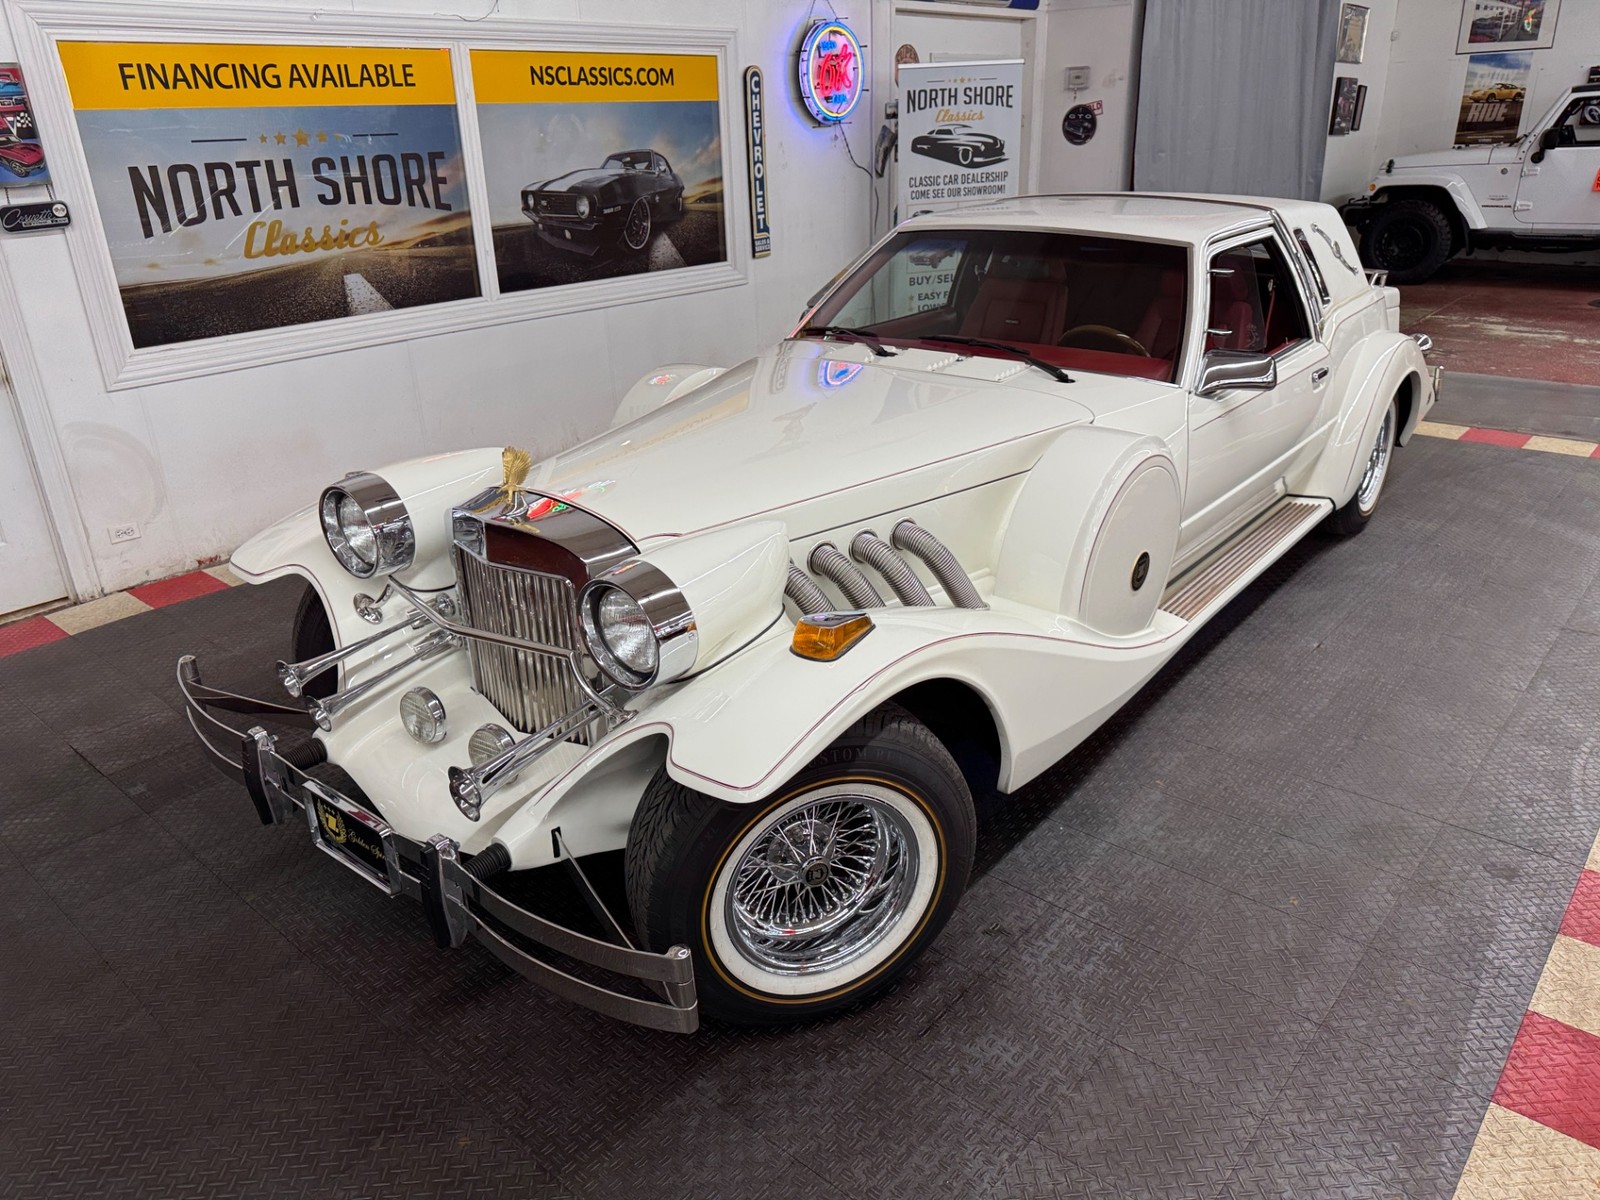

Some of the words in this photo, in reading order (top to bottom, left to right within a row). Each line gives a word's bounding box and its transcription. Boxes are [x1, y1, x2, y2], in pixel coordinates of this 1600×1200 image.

[118, 63, 281, 91] FINANCING
[289, 63, 416, 88] AVAILABLE
[530, 65, 674, 86] NSCLASSICS.COM
[906, 87, 958, 114] NORTH
[964, 85, 1014, 108] SHORE
[935, 109, 985, 123] Classics
[1466, 102, 1509, 122] RIDE
[751, 76, 766, 229] CHEVROLET
[908, 175, 941, 188] CLASSIC
[943, 174, 959, 186] CAR
[961, 170, 1009, 185] DEALERSHIP
[127, 158, 301, 239] NORTH
[313, 151, 452, 211] SHORE
[910, 188, 931, 200] COME
[932, 187, 945, 198] SEE
[947, 187, 962, 198] OUR
[963, 184, 1006, 197] SHOWROOM!
[3, 208, 54, 228] Corvette
[243, 216, 385, 260] Classics
[917, 291, 942, 301] EASY
